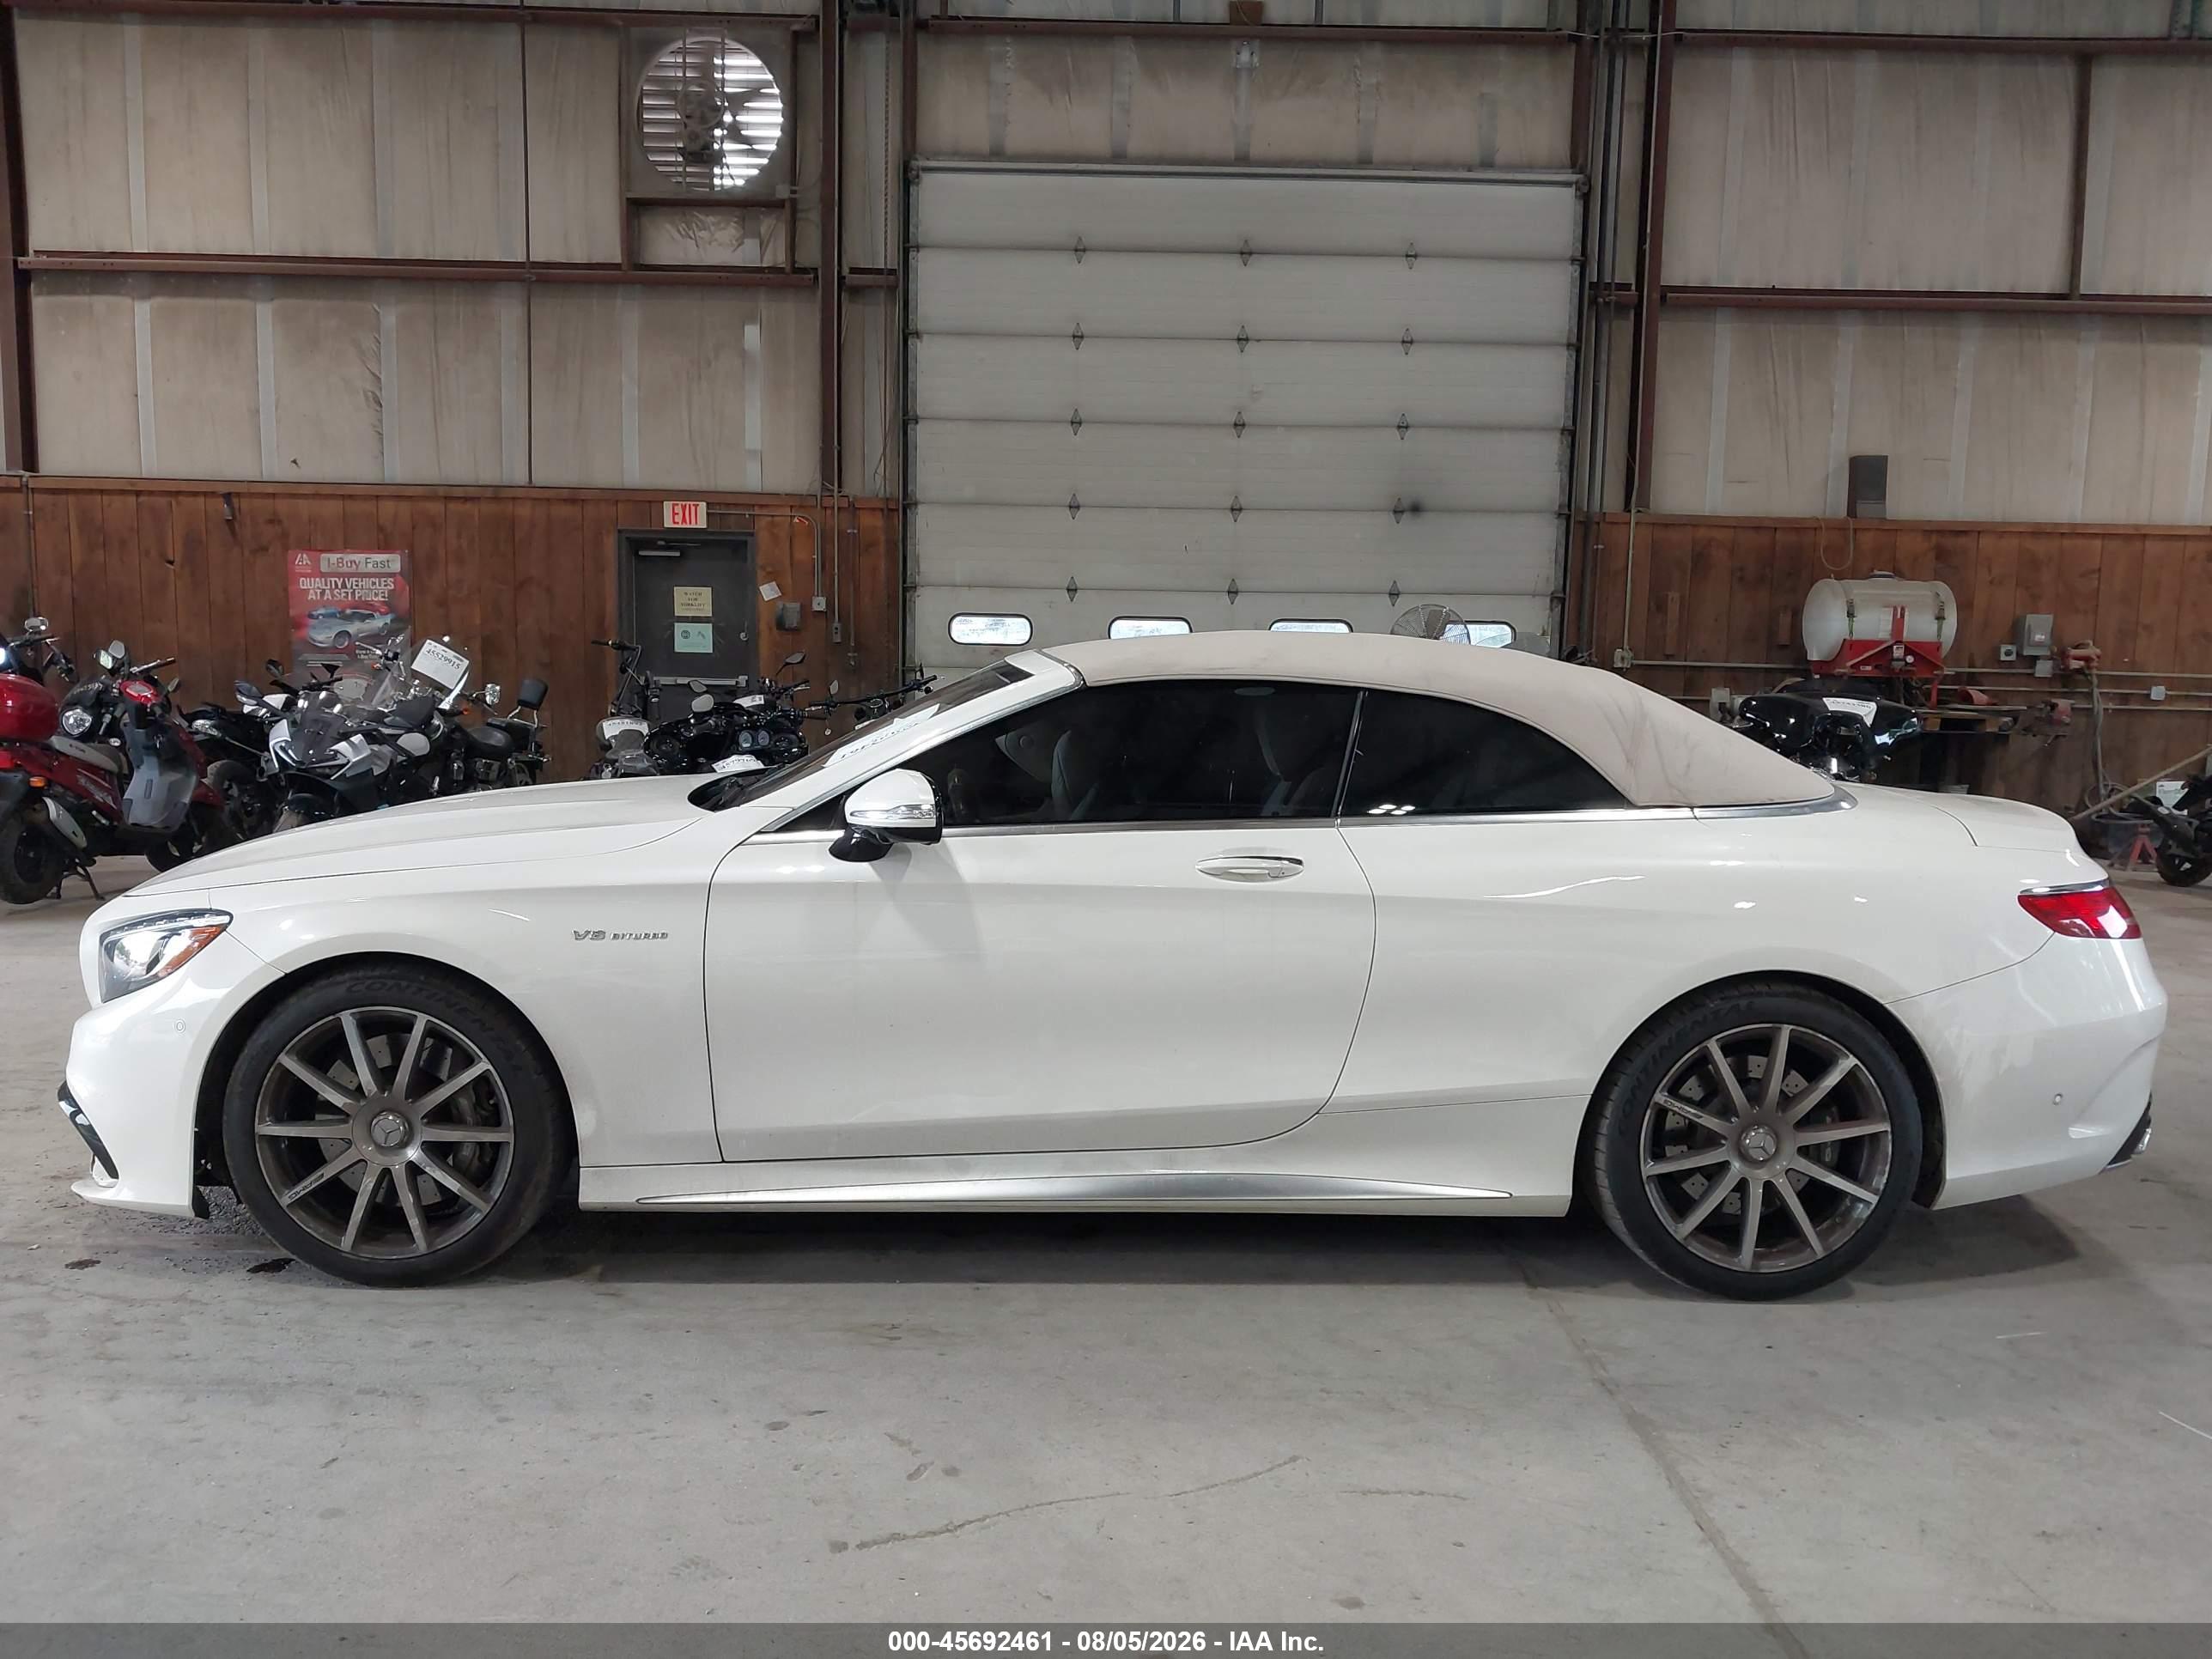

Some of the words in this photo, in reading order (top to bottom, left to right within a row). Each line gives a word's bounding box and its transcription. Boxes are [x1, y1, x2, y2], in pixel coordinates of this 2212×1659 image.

[672, 503, 700, 526] EXIT
[327, 557, 361, 571] I-Buy
[365, 557, 392, 569] Fast
[299, 577, 343, 590] QUALITY
[345, 577, 395, 590] VEHICLES
[308, 589, 322, 600] AT
[324, 589, 332, 600] A
[334, 589, 353, 600] SET
[425, 647, 461, 670] 45529915
[573, 930, 606, 940] V8
[611, 932, 669, 940] BITURBO
[288, 1182, 312, 1200] AMG
